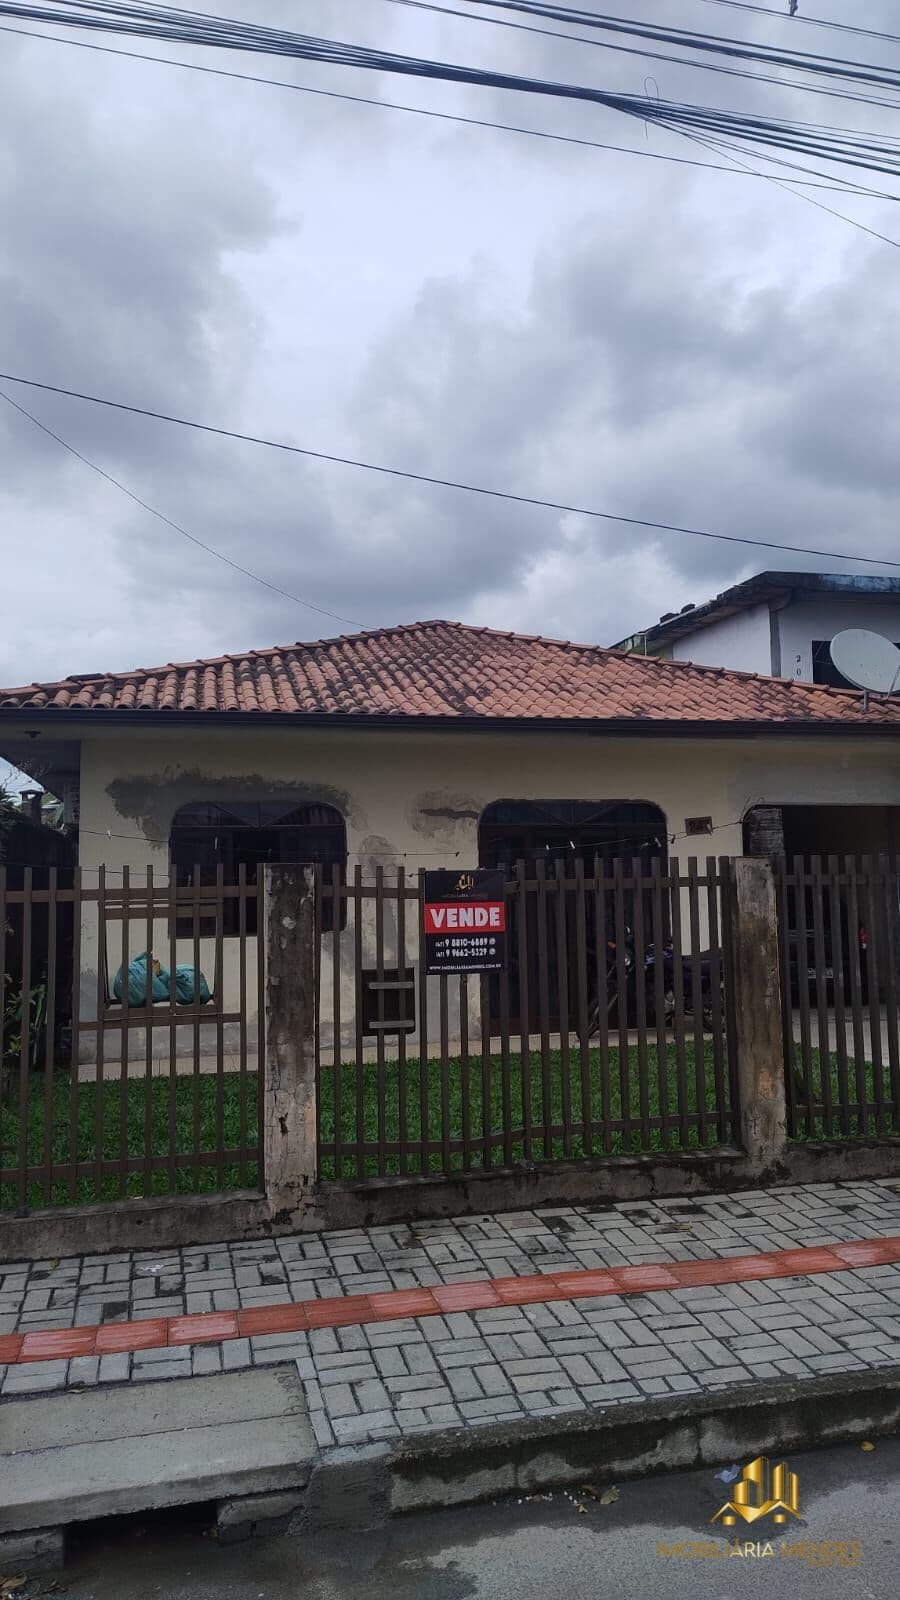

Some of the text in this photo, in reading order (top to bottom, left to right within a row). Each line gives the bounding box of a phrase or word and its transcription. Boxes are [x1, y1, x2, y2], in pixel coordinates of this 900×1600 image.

[430, 906, 500, 928] VENDE
[445, 938, 450, 948] 9
[445, 948, 450, 958] 9
